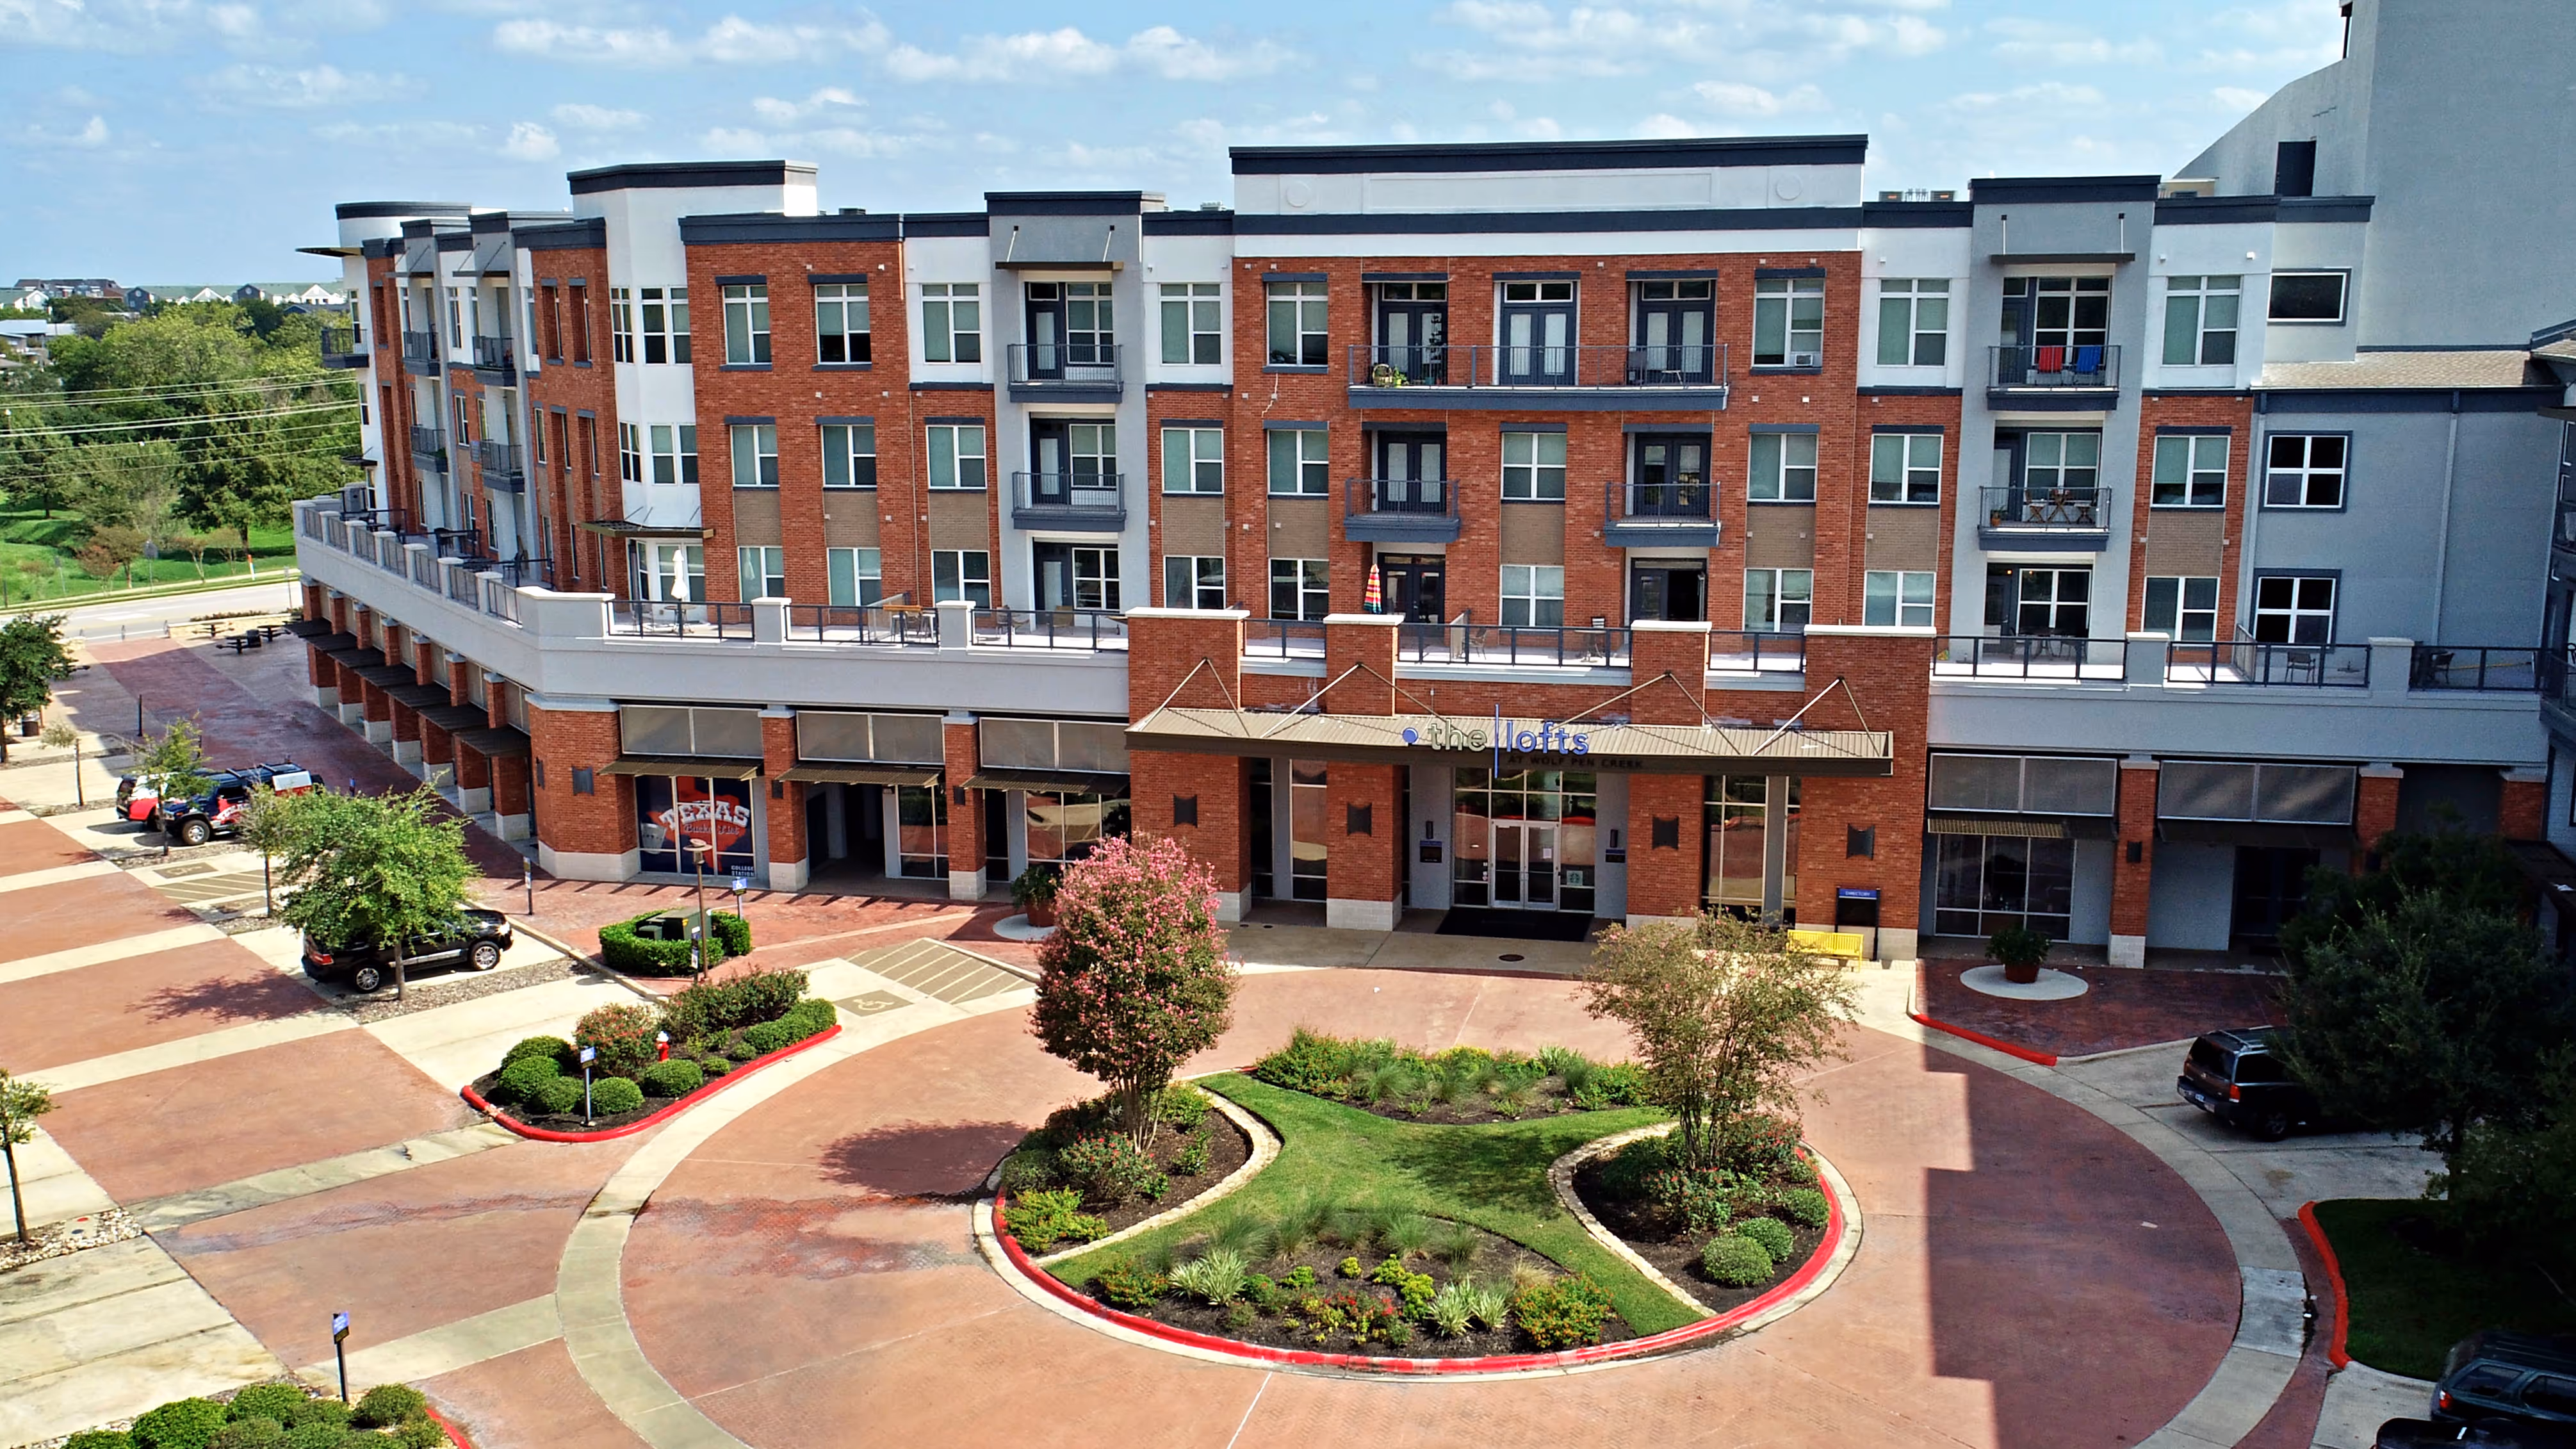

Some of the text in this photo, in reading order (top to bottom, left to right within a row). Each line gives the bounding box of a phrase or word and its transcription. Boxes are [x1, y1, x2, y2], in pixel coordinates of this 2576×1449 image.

[1428, 717, 1589, 755] the lofts
[1508, 755, 1643, 768] AT WOLF PEN CREEK
[659, 800, 750, 831] TEXAS
